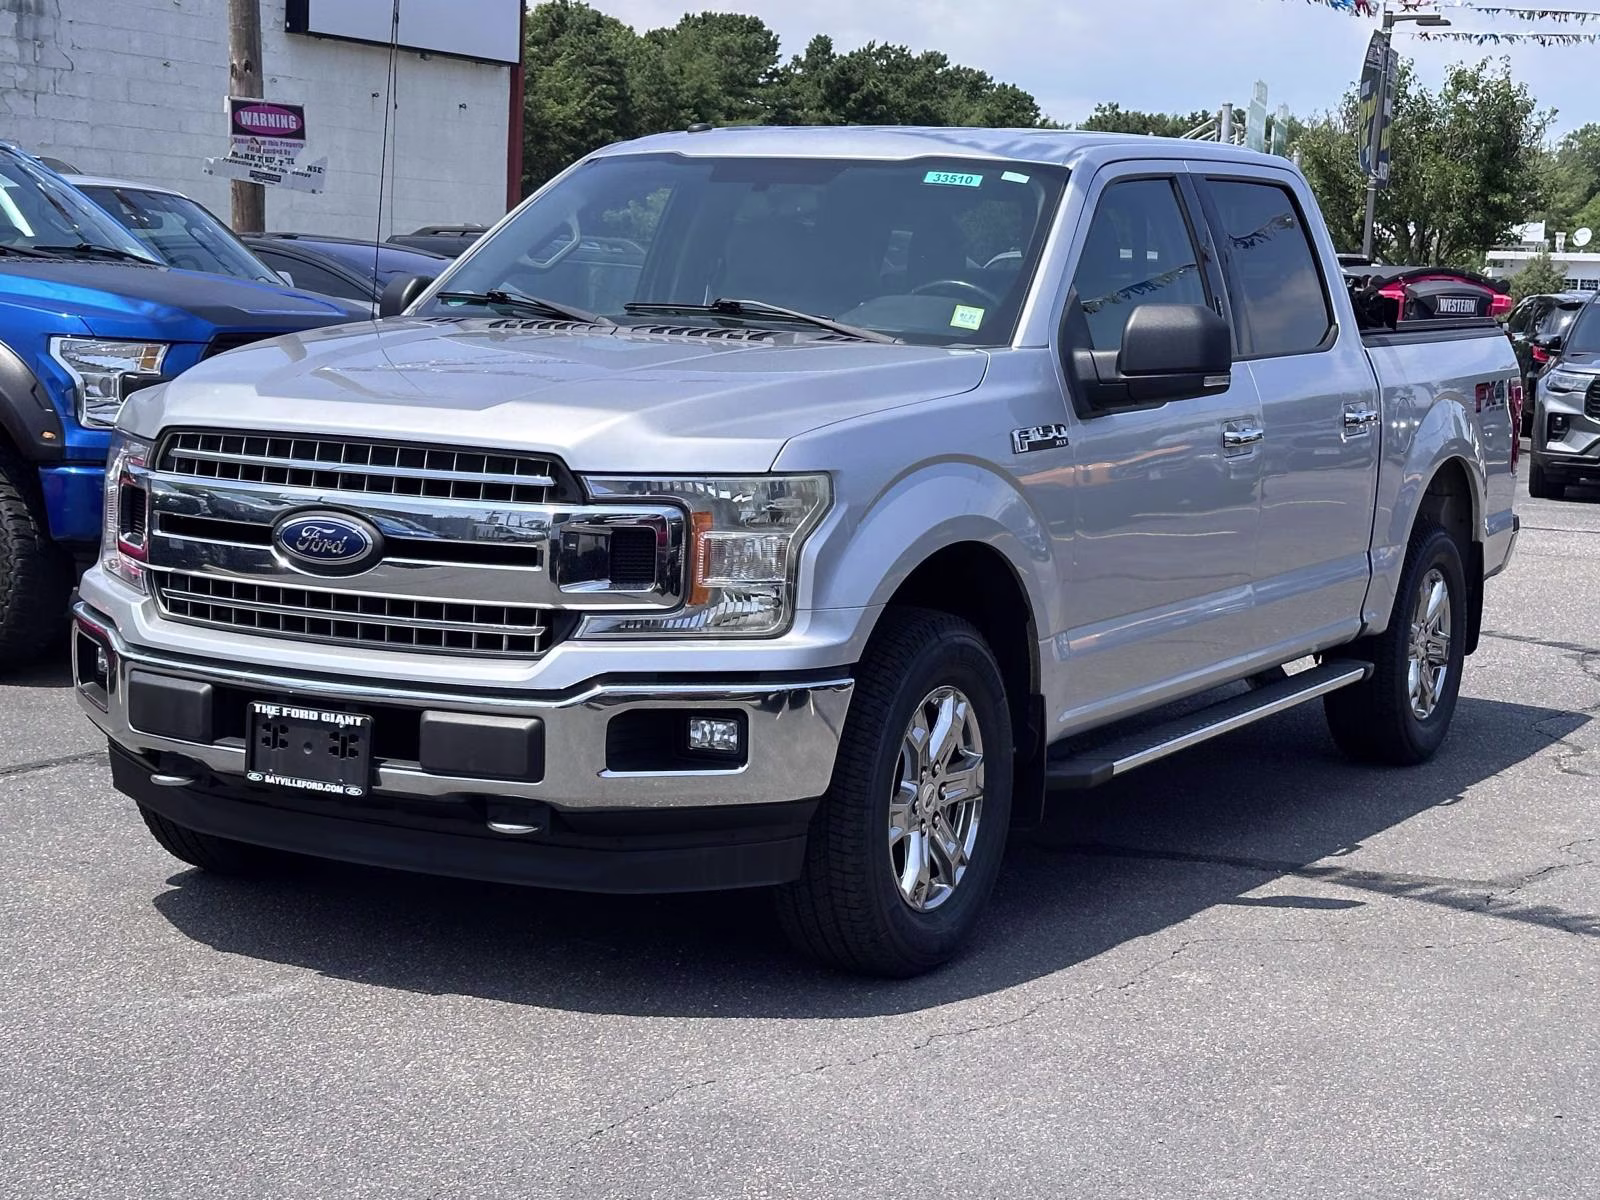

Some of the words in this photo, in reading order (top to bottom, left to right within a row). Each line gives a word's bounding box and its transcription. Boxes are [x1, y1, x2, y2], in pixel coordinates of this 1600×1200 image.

[240, 111, 297, 129] WARNING
[932, 173, 974, 185] 33510
[1439, 298, 1476, 313] WESTERN
[1475, 380, 1504, 413] FX4
[296, 525, 349, 555] Ford
[253, 703, 280, 716] THE
[282, 707, 318, 721] FORD
[321, 712, 363, 727] GIANT
[264, 774, 344, 794] SAYVILLEFORD.COM
